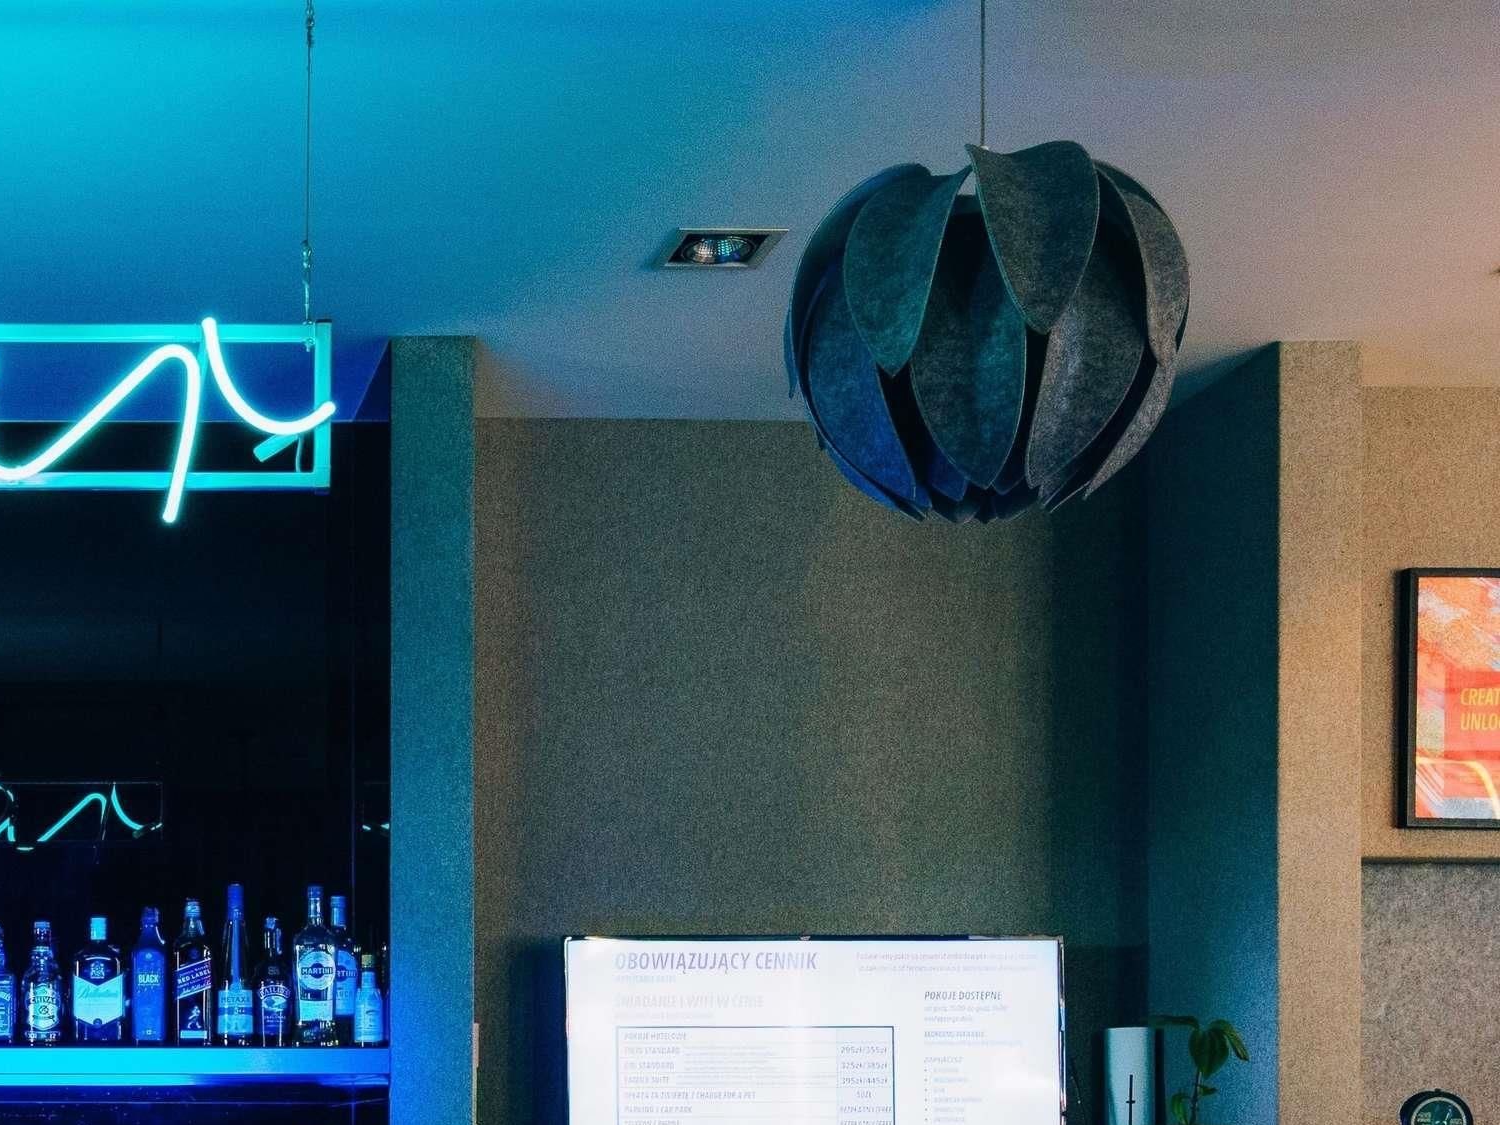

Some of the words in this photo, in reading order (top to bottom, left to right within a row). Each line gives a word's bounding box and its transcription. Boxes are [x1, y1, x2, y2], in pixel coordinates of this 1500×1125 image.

[1460, 713, 1500, 730] UNLO
[615, 951, 750, 975] OBOWIĄZUJĄCY
[755, 951, 818, 971] CENNIK
[302, 967, 333, 975] MARTINI
[138, 974, 159, 984] BLACK
